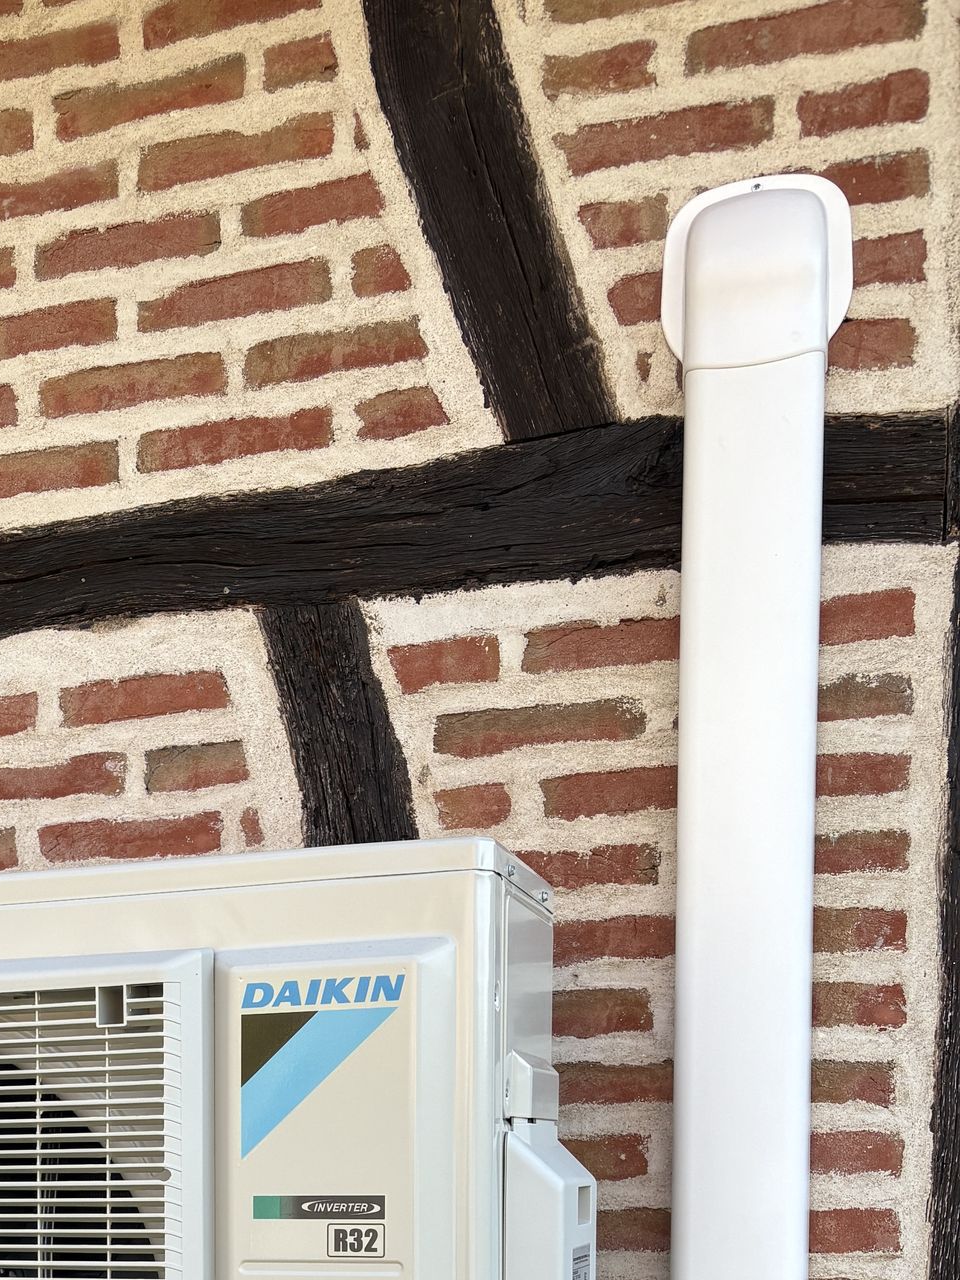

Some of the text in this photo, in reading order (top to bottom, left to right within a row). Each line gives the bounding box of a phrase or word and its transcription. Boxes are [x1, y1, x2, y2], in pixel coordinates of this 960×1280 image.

[241, 974, 406, 1009] DAIKIN
[313, 1202, 369, 1213] INVERTER
[333, 1228, 379, 1253] R32
